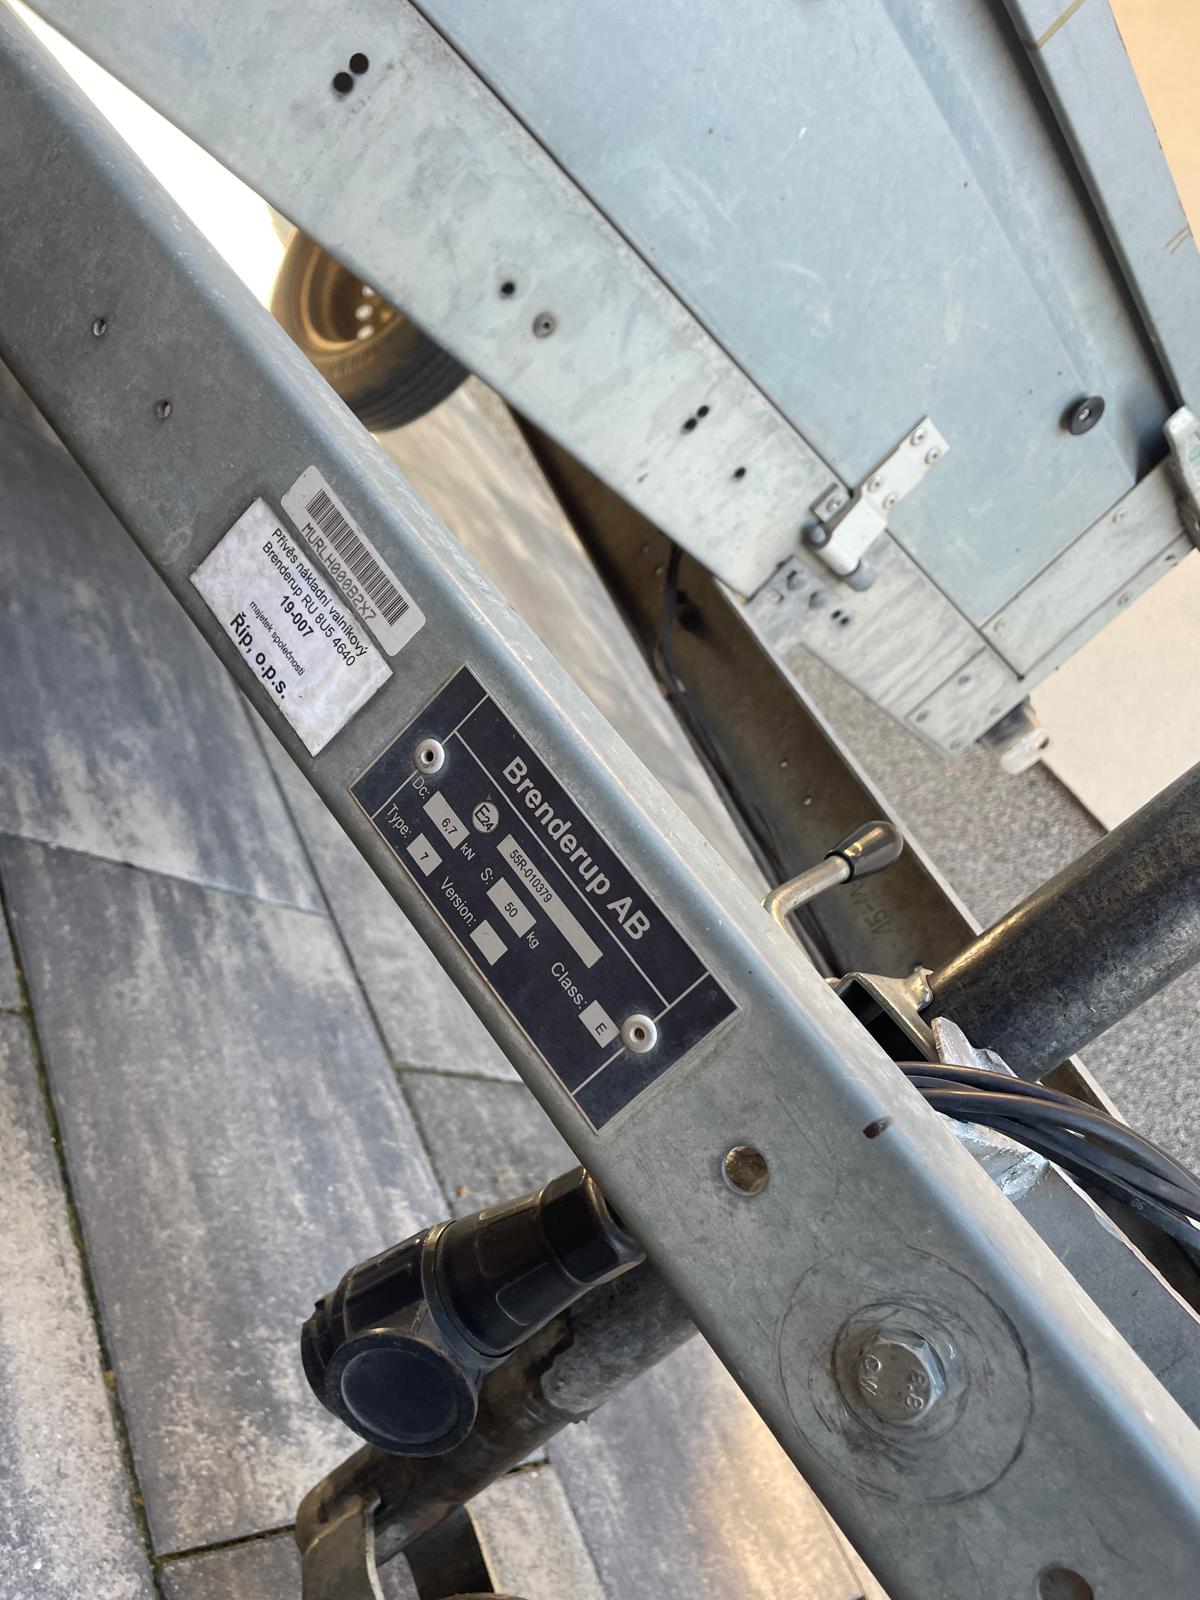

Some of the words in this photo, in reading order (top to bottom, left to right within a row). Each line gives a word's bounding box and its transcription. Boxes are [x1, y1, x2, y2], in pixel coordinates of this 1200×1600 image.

[262, 541, 302, 597] Brenderup
[300, 594, 319, 615] RU
[313, 613, 335, 638] 8U5
[330, 636, 356, 667] 4640
[271, 527, 300, 564] Přívěs
[295, 560, 333, 608] nákladní
[327, 606, 369, 657] valníkový
[278, 594, 314, 638] 19-007
[229, 611, 260, 653] Říp,
[251, 652, 291, 699] o.p.s.
[248, 600, 274, 633] majetek
[269, 630, 306, 676] společnosti
[475, 804, 495, 831] E24
[502, 756, 615, 900] Brenderup
[607, 892, 653, 942] AB
[384, 803, 413, 839] Type:
[417, 851, 429, 863] 7
[437, 876, 478, 927] Version:
[412, 776, 432, 799] Dc:
[439, 817, 458, 837] 6,7
[459, 842, 476, 860] kN
[478, 867, 495, 885] S:
[502, 900, 519, 918] 50
[524, 931, 540, 950] kg
[548, 960, 588, 1009] Class:
[593, 1022, 606, 1035] E
[507, 848, 553, 903] 55R-010379
[906, 1369, 928, 1410] 8.8
